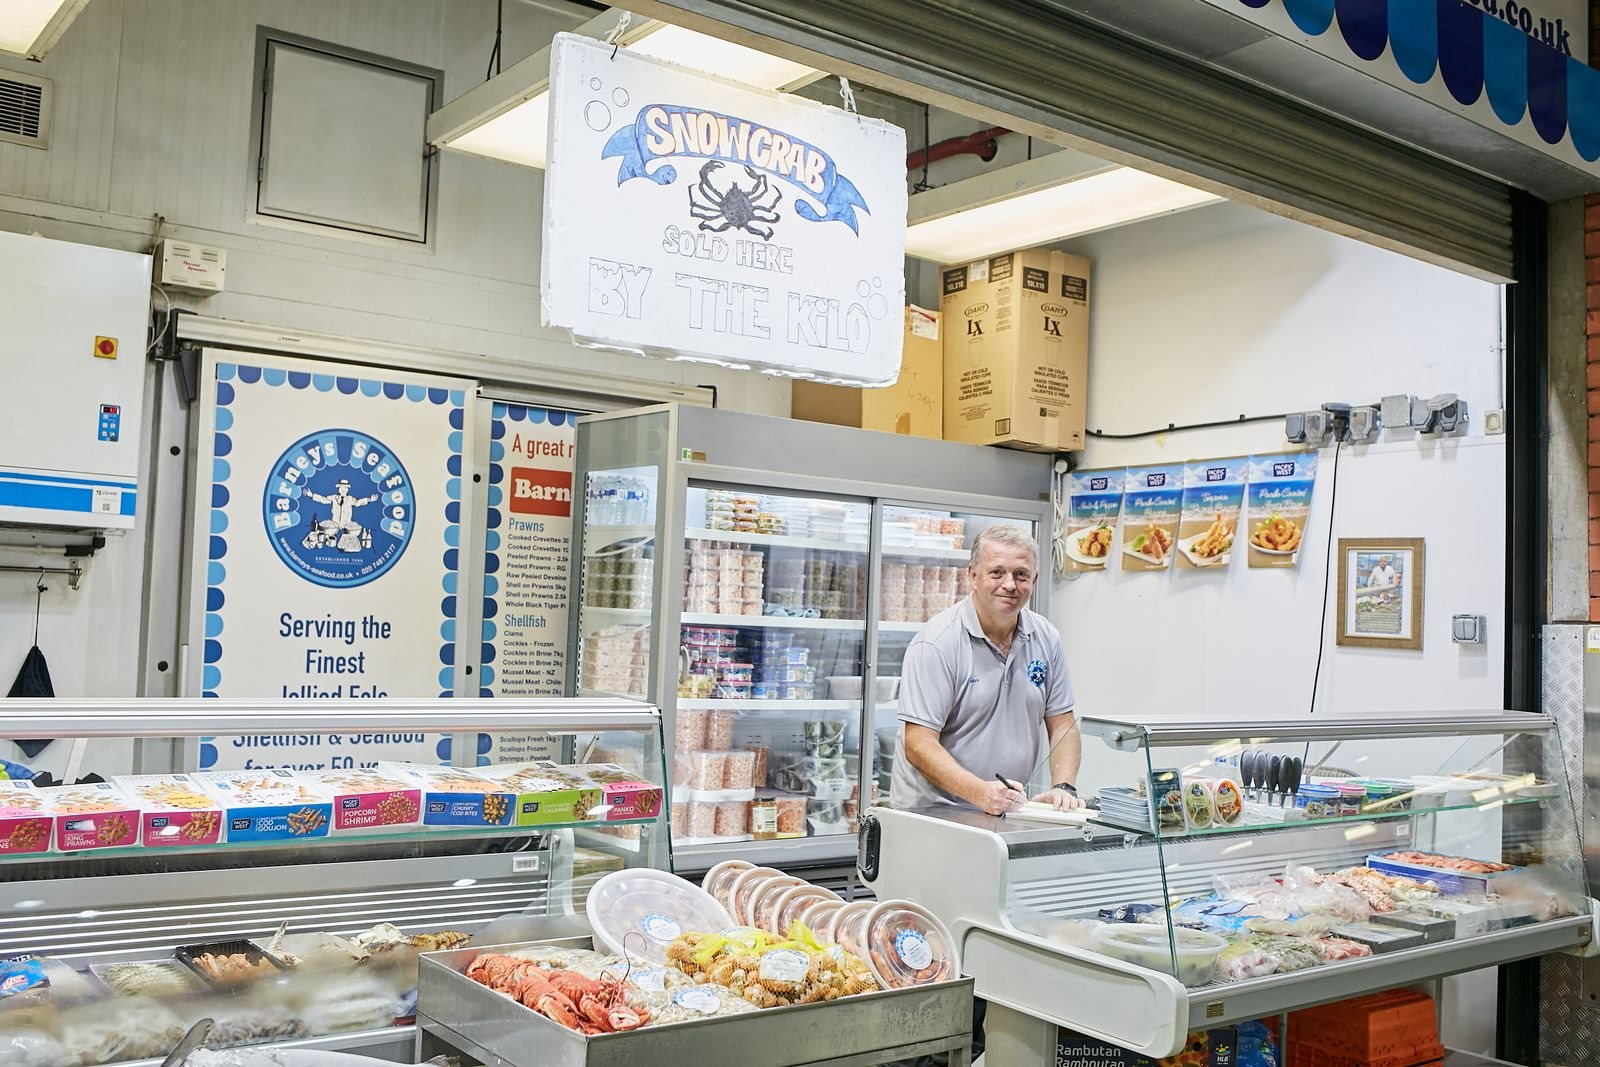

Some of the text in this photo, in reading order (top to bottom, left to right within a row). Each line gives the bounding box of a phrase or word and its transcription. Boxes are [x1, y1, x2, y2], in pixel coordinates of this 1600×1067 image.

[1471, 0, 1571, 56] .co.uk
[662, 224, 794, 274] SOLD HERE
[588, 256, 653, 320] BY
[675, 272, 771, 340] THE
[967, 304, 986, 315] DART
[1044, 306, 1064, 314] DART
[512, 433, 522, 452] A
[527, 440, 564, 459] great
[273, 440, 406, 538] Barneys Seafood
[514, 478, 571, 502] Barn
[508, 518, 545, 532] Prawns
[279, 612, 391, 645] Serving the
[504, 614, 546, 628] Shellfish
[306, 649, 365, 674] Finest
[344, 816, 377, 826] SHRIMP
[67, 839, 96, 847] PRAWNS
[1057, 1044, 1121, 1057] Rambutan
